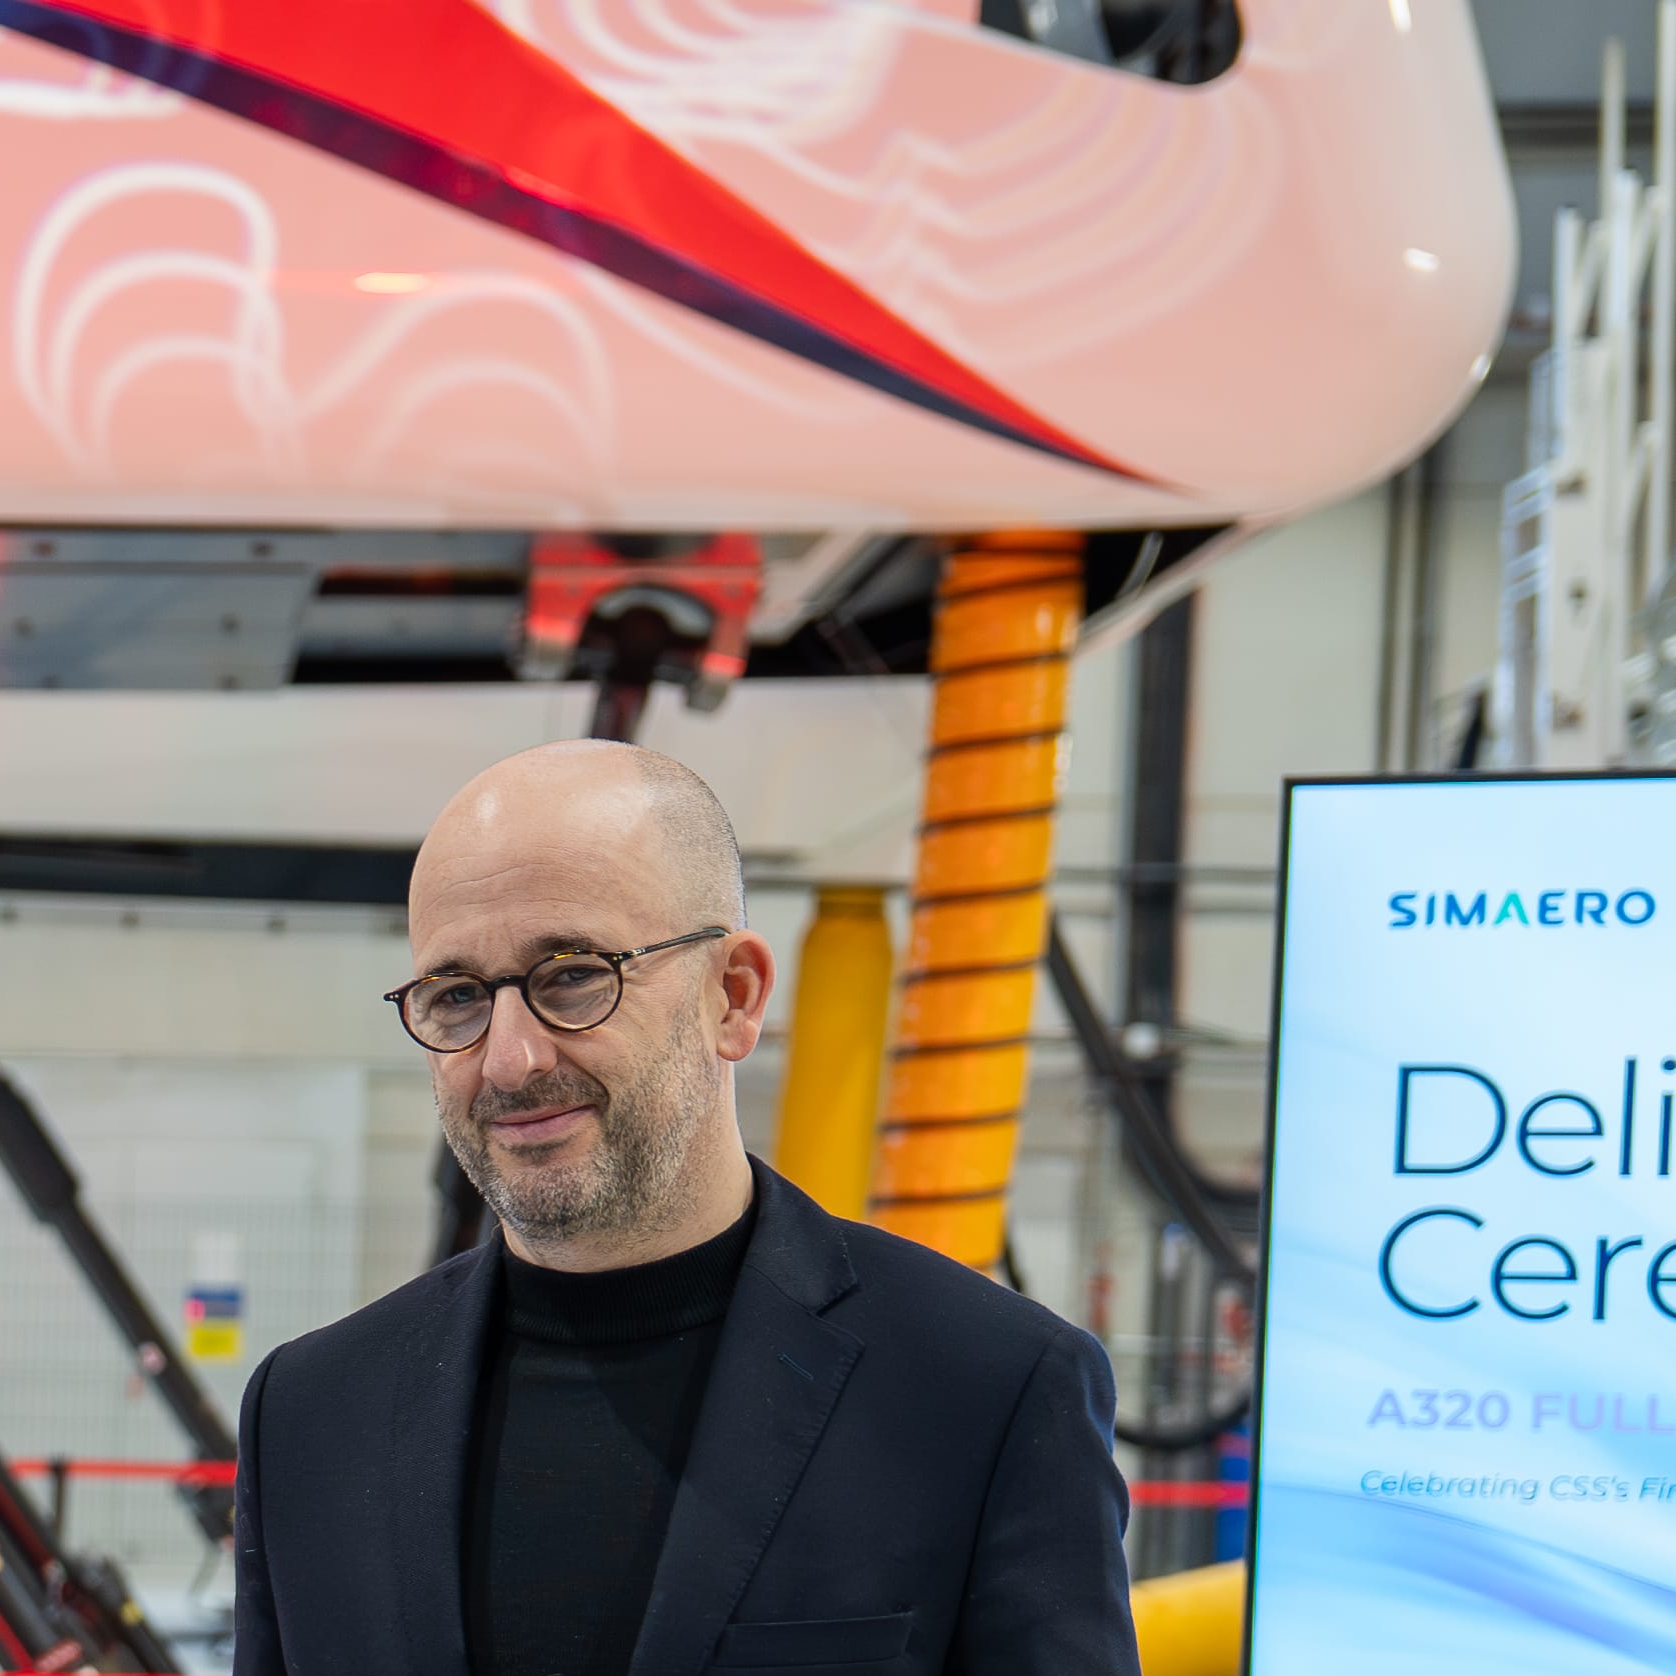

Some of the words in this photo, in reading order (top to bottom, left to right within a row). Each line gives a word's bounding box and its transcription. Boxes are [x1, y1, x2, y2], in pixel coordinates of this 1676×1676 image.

[1389, 889, 1656, 928] SIMAERO
[1394, 1056, 1676, 1176] Deli
[1367, 1388, 1510, 1429] A320
[1531, 1391, 1676, 1433] FULL
[1360, 1469, 1539, 1502] Celebrating
[1550, 1474, 1631, 1500] CSS's
